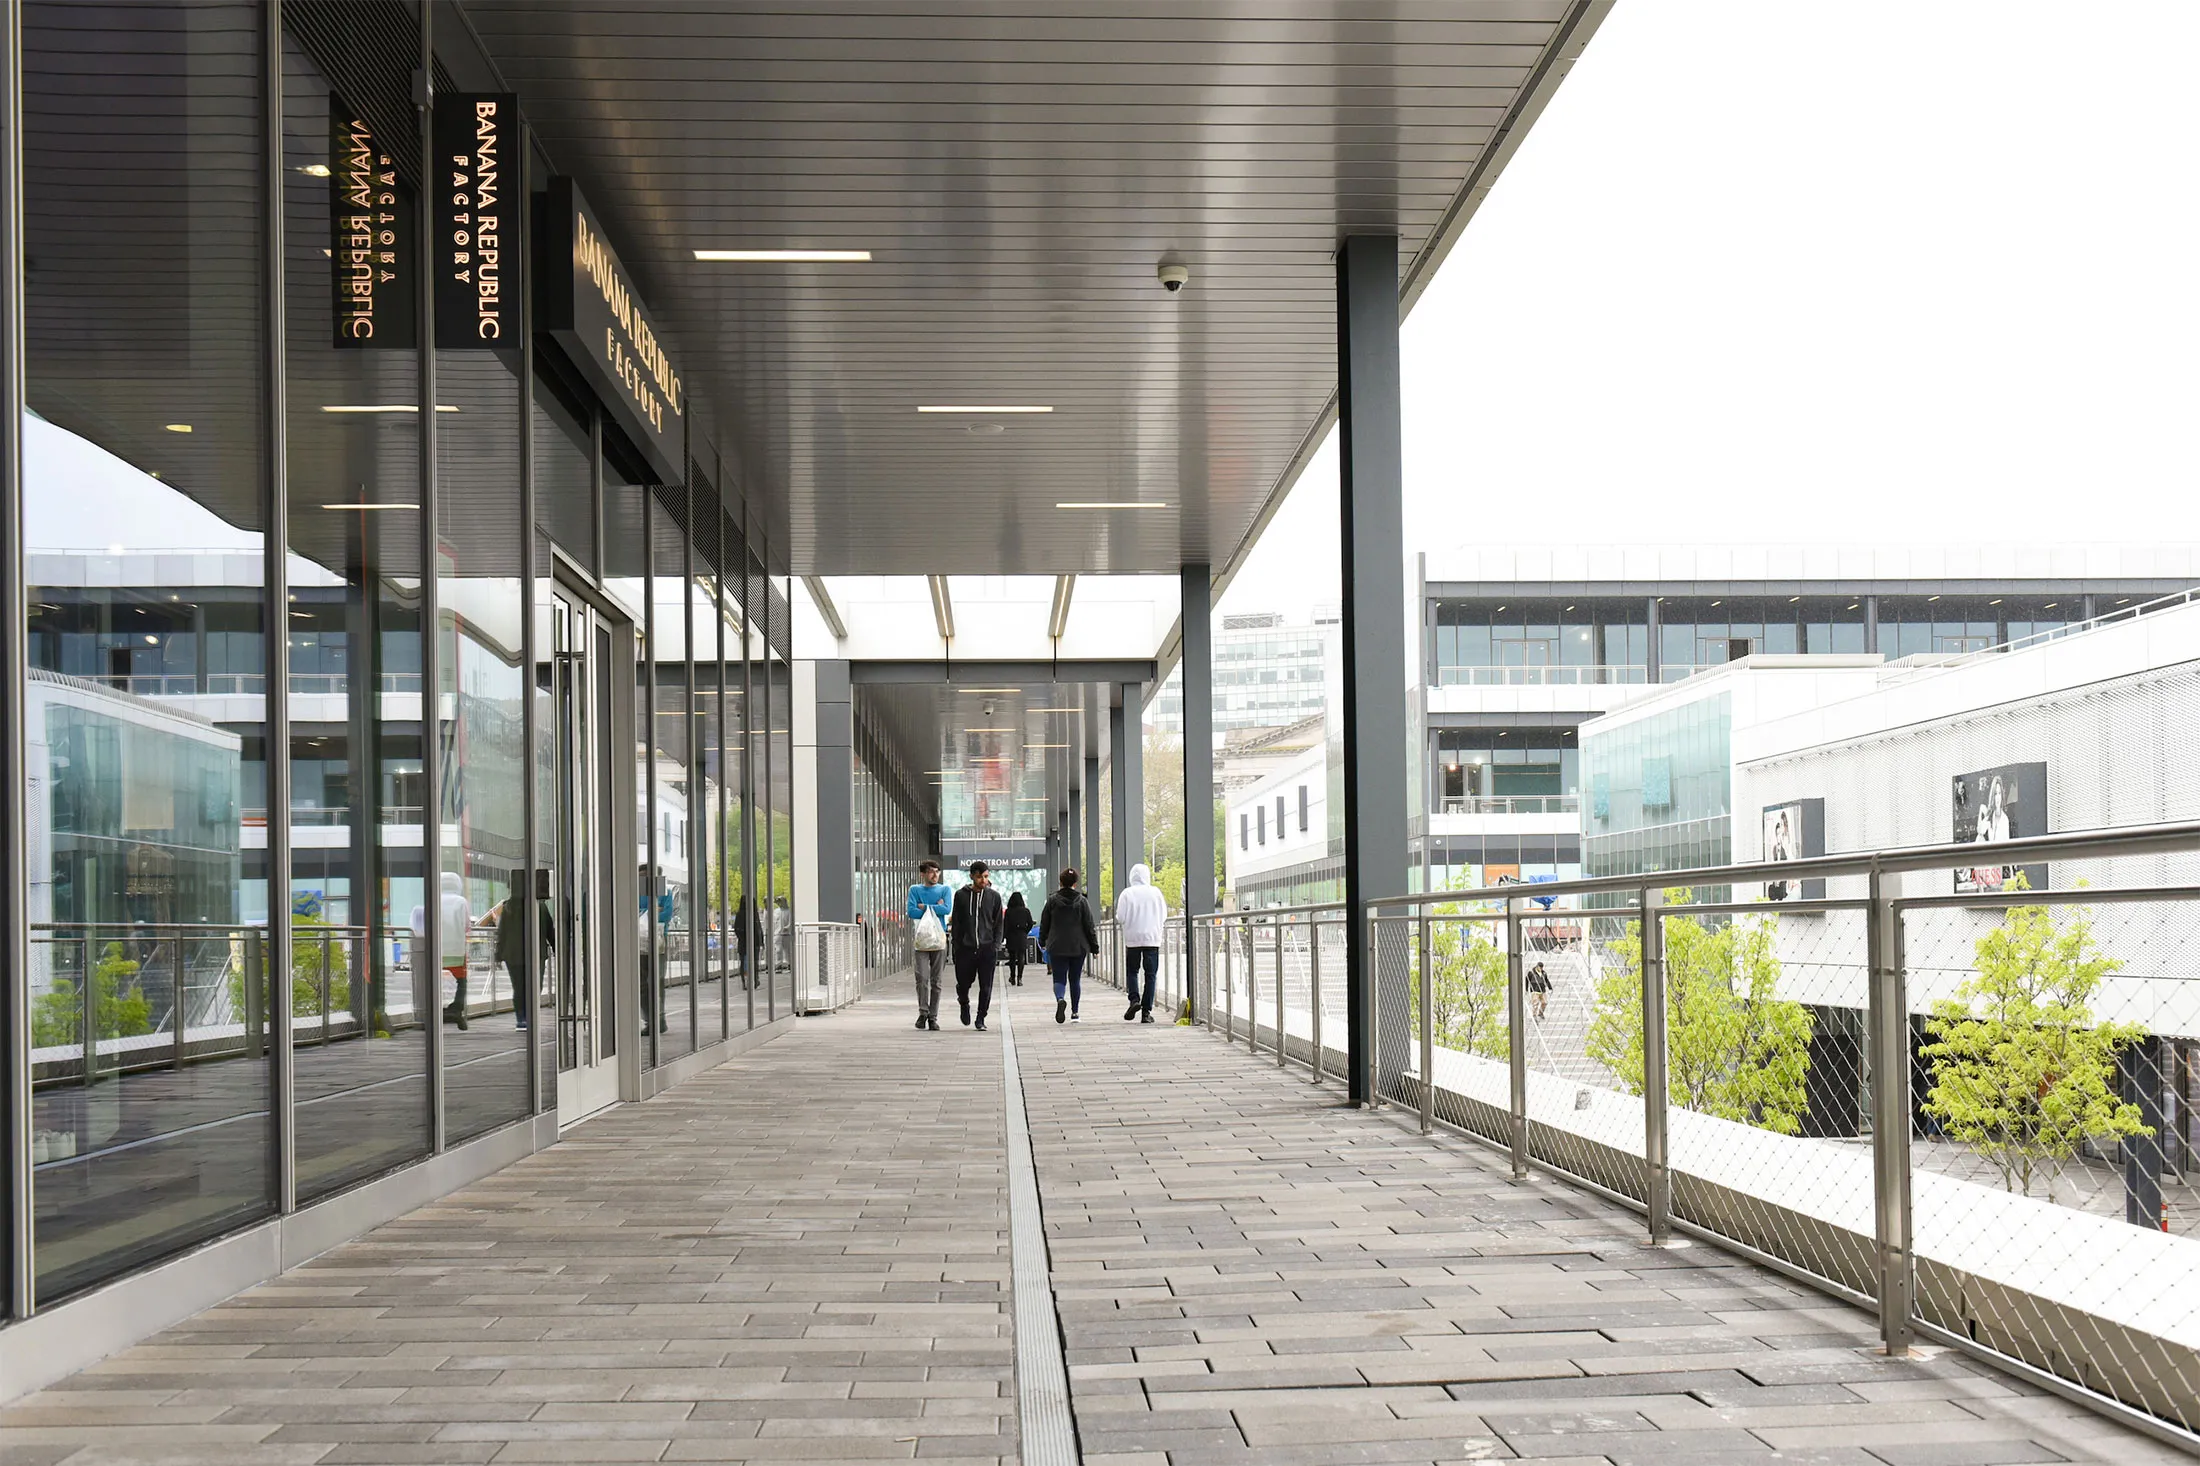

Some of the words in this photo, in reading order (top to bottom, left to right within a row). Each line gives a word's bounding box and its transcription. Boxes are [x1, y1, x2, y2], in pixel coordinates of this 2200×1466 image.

[475, 101, 497, 210] BANANA
[453, 155, 470, 284] FACTORY
[477, 215, 500, 339] REPUBLIC
[578, 211, 633, 341] BANANA
[633, 306, 682, 416] REPUBLIC
[606, 327, 663, 434] FACTORY
[1011, 856, 1031, 866] rack
